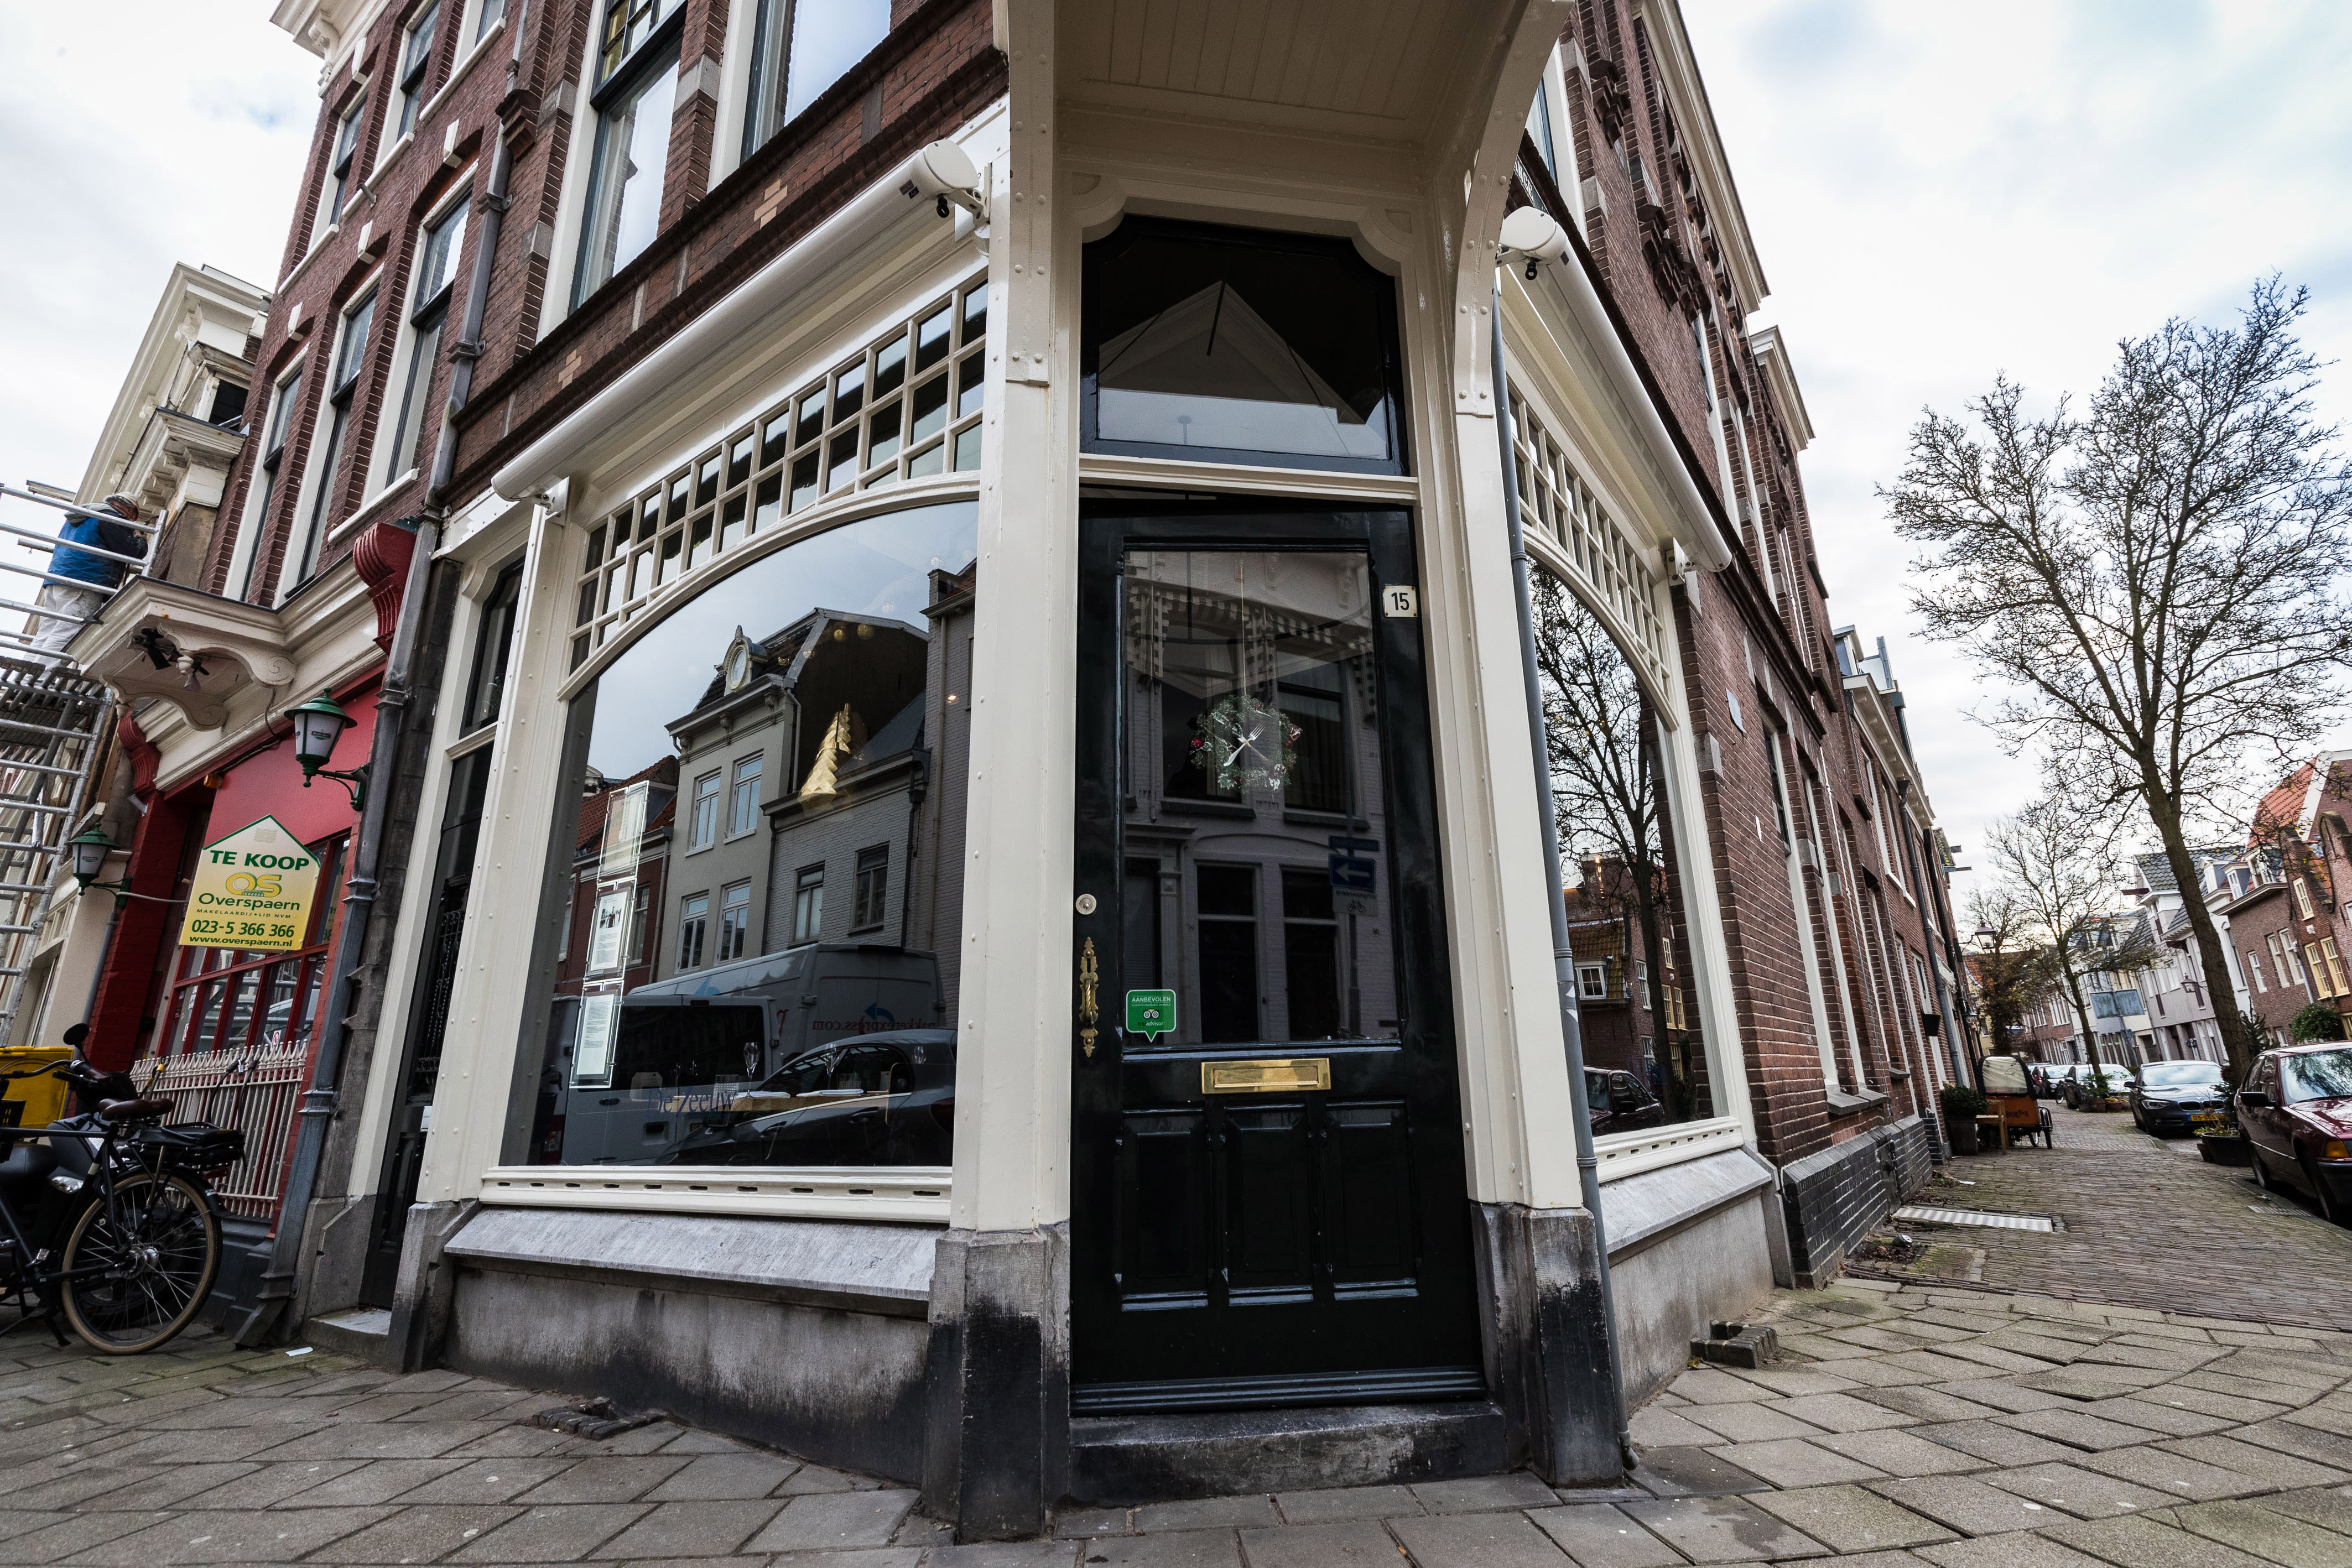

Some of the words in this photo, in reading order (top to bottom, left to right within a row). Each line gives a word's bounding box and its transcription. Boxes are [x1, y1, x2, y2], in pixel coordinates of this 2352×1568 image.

[1391, 592, 1410, 611] 15
[210, 850, 237, 864] TE
[244, 853, 309, 871] KOOP
[198, 893, 300, 910] Overspaern
[191, 919, 235, 934] 023-5
[238, 922, 264, 936] 366
[269, 924, 295, 937] 366
[189, 936, 292, 947] www.overspaern.nl
